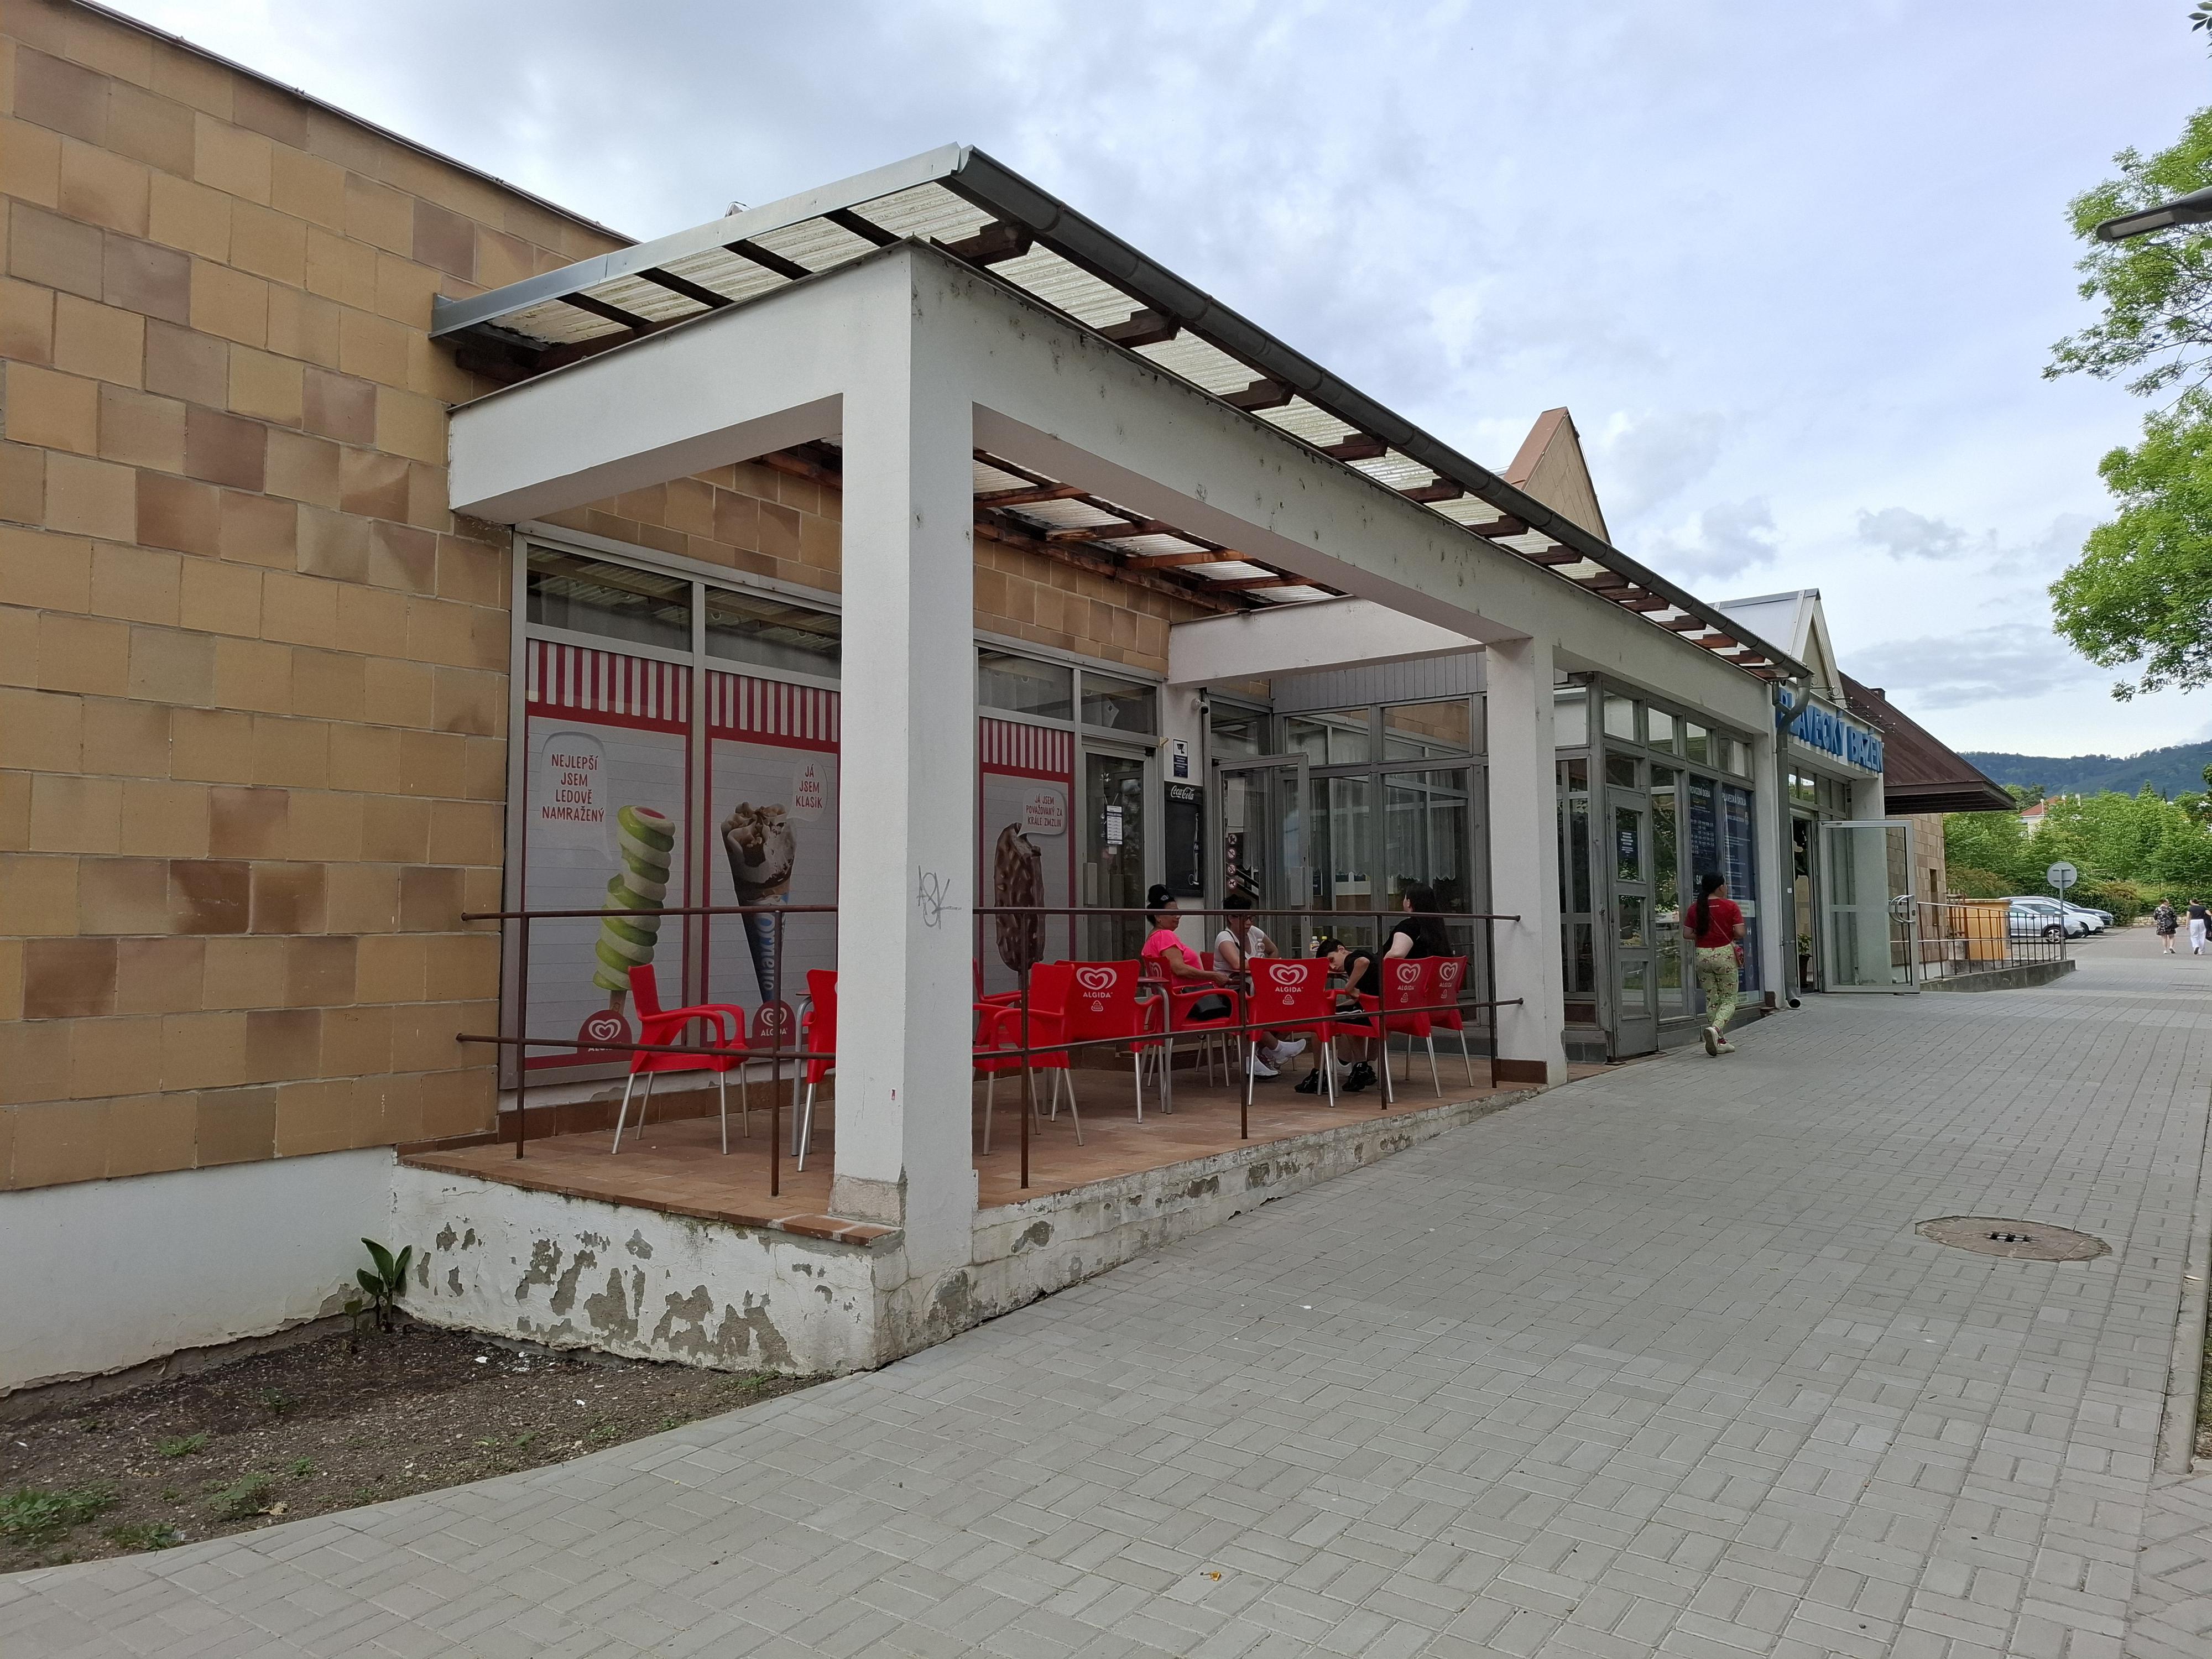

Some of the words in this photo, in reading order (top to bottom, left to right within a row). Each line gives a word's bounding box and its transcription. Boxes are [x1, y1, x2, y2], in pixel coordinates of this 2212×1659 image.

[1846, 726, 1883, 773] BAZÉN
[551, 754, 598, 770] NEJLEPŠÍ
[805, 764, 814, 778] JÁ
[561, 772, 588, 787] JSEM
[799, 780, 820, 793] JSEM
[556, 789, 592, 804] LEDOVĚ
[1035, 793, 1041, 804] JÁ
[1042, 796, 1055, 805] JSEM
[542, 806, 604, 822] NAMRAŽENÝ
[1026, 805, 1055, 816] POVAŽOVANÝ
[1056, 808, 1063, 816] ZA
[1027, 815, 1042, 826] KRÁLE
[1044, 818, 1062, 827] ZMZLIN
[760, 1028, 787, 1036] ALGA
